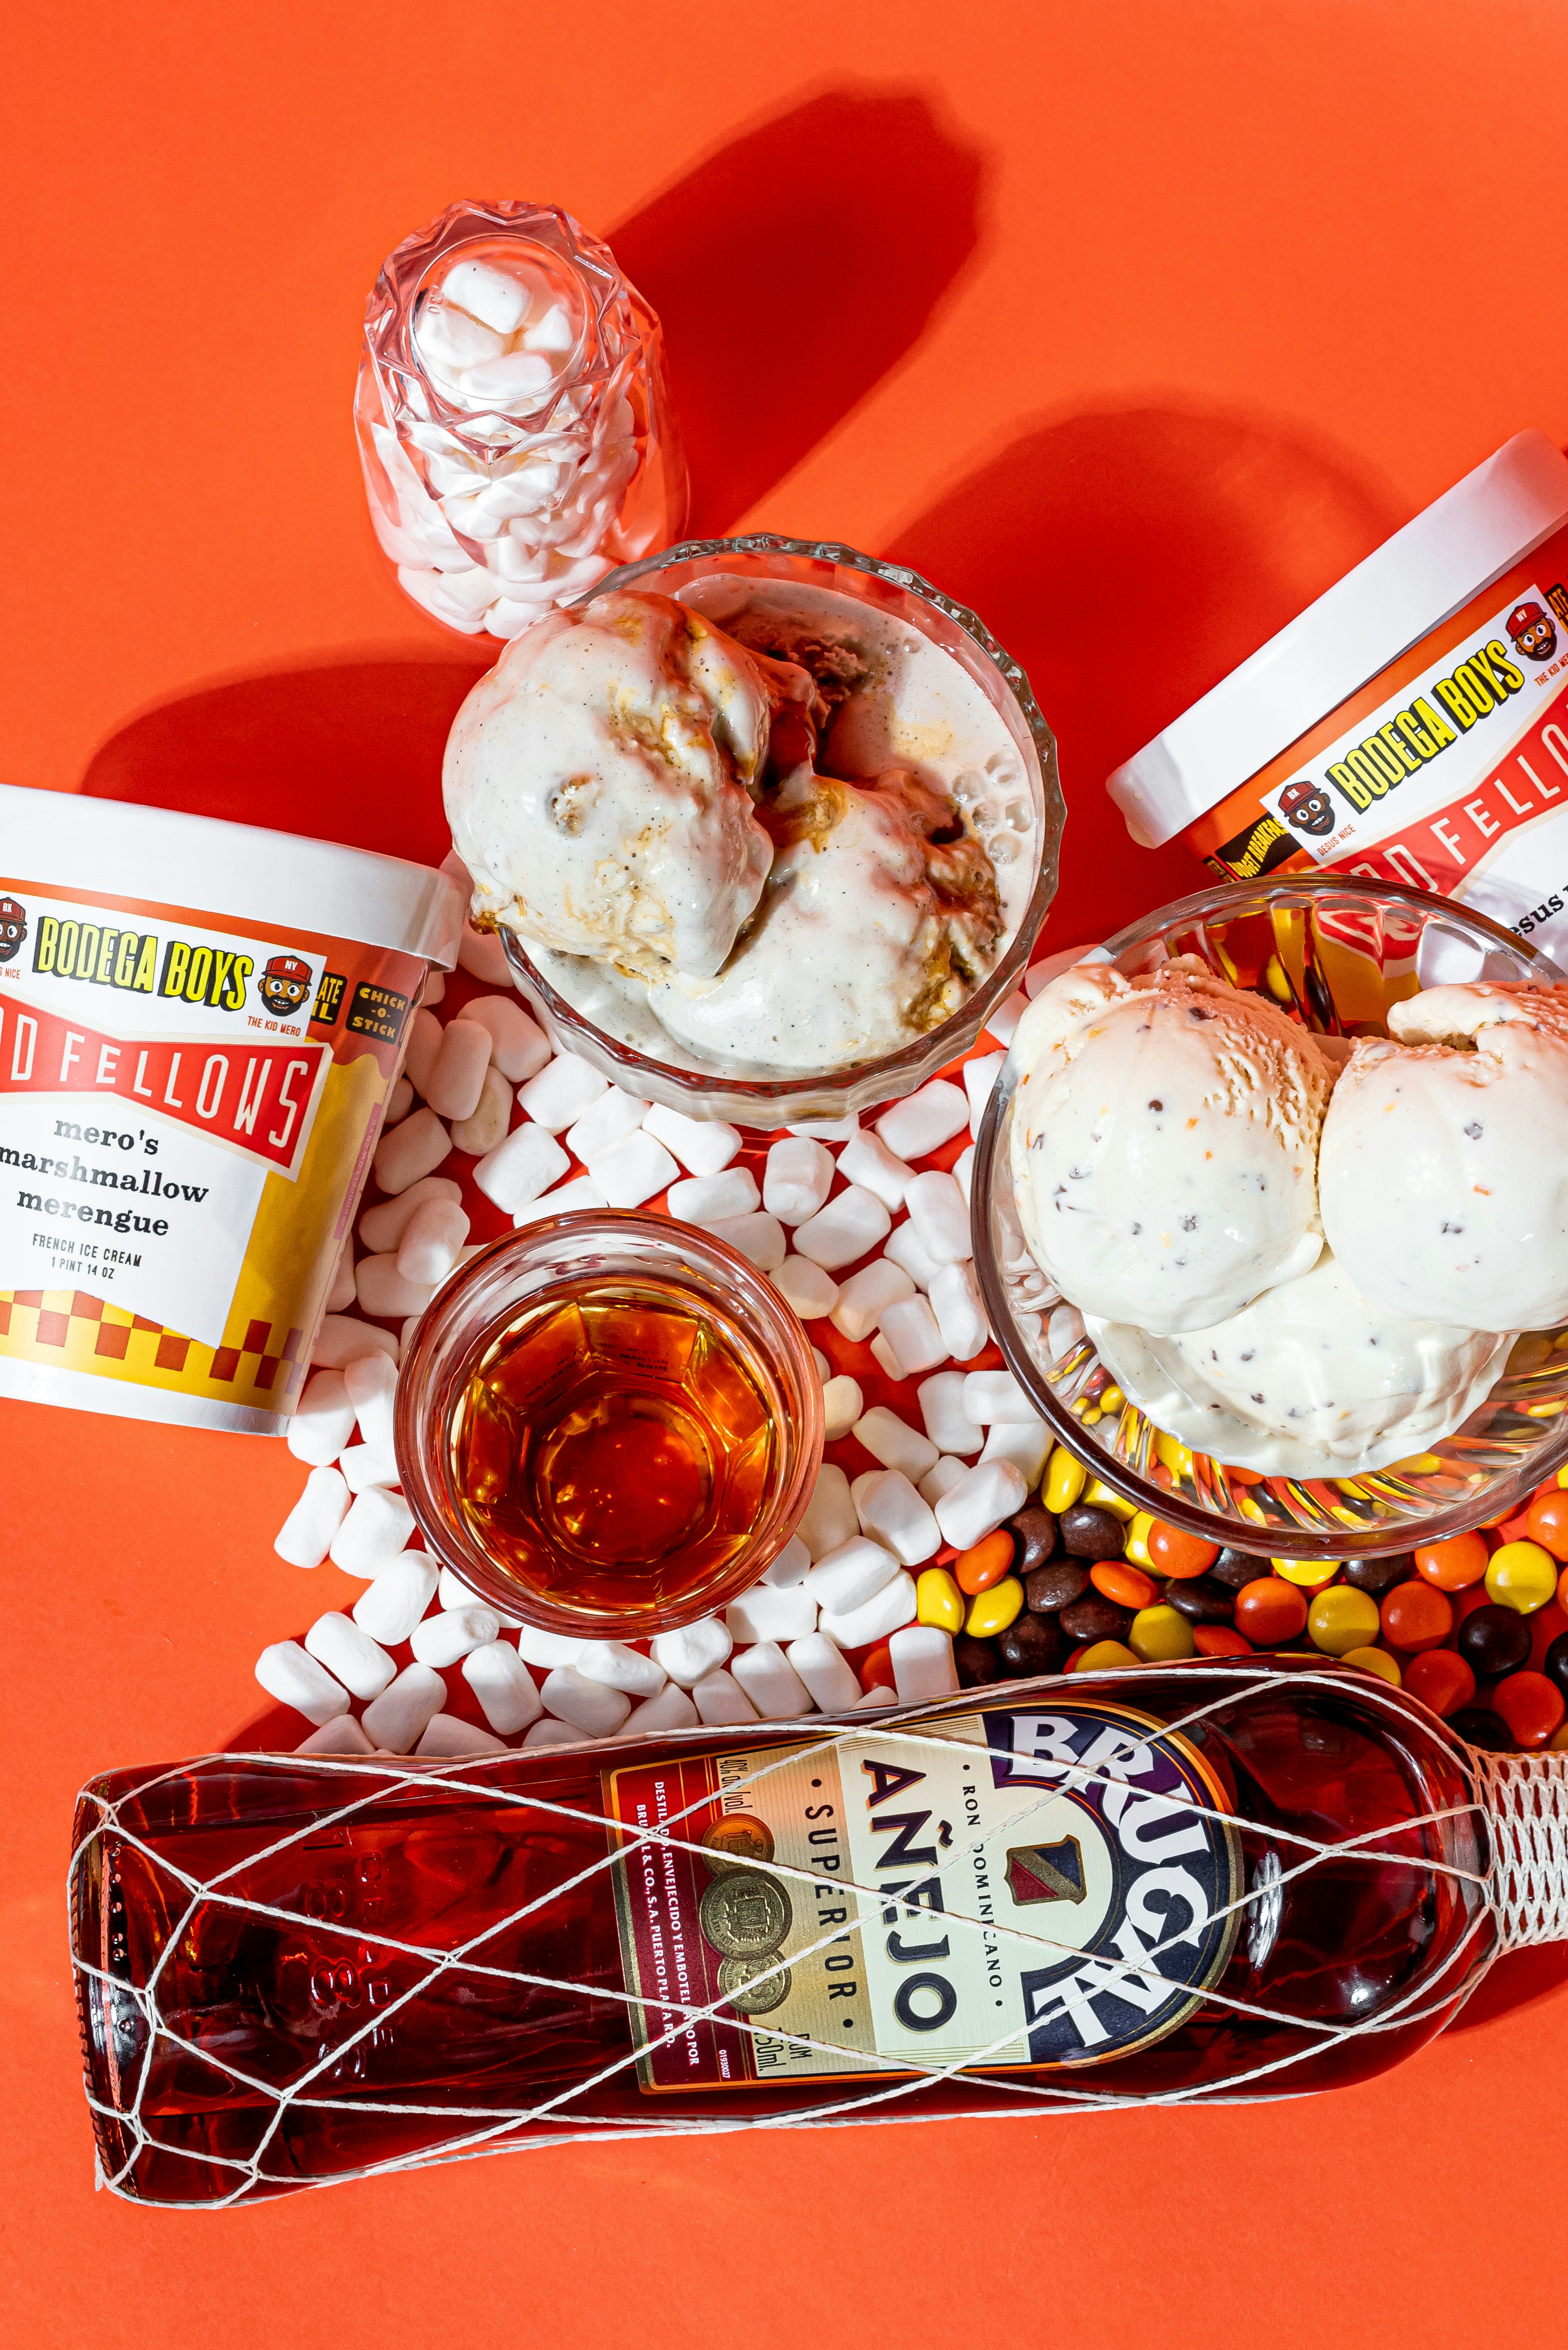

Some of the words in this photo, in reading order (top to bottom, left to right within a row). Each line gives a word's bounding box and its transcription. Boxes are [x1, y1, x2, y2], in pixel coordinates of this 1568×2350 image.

[1516, 609, 1528, 622] NY
[1534, 672, 1549, 687] THE
[1547, 663, 1560, 678] KID
[1325, 697, 1458, 814] BODEGA
[1431, 640, 1525, 734] BOYS
[1287, 788, 1300, 800] BK
[1429, 723, 1568, 865] FELLO
[1226, 851, 1261, 878] BUDGET
[1247, 817, 1289, 863] BREAKFAS
[1317, 837, 1340, 856] DESUS
[1337, 824, 1357, 840] NICE
[3, 903, 12, 913] BK
[5, 967, 21, 979] NICE
[32, 916, 158, 994] BODEGA
[157, 940, 254, 1012] BOYS
[285, 959, 298, 971] NY
[359, 988, 405, 1012] CHICK
[248, 1015, 263, 1028] THE
[265, 1019, 277, 1031] KID
[280, 1024, 301, 1037] MERO
[352, 1016, 397, 1039] STICK
[59, 1029, 308, 1148] FELLOWS
[53, 1120, 159, 1155] mero's
[0, 1146, 209, 1203] marshmallow
[17, 1191, 169, 1236] merengue
[33, 1233, 75, 1254] FRENCH
[80, 1243, 99, 1258] ICE
[103, 1248, 142, 1267] CREAM
[51, 1256, 56, 1267] 1
[60, 1259, 83, 1273] PINT
[87, 1264, 97, 1275] 14
[102, 1267, 115, 1280] OZ
[719, 1759, 749, 1774] 40%
[962, 1785, 981, 1827] RON
[642, 1855, 652, 1866] &
[861, 1758, 958, 2033] AÑEJO
[1007, 1715, 1211, 2048] BRUGAL
[804, 1804, 855, 2000] SUPERIOR
[651, 1925, 667, 1976] PUERTO
[662, 1852, 682, 1930] ENVEJECIDO
[687, 2041, 699, 2065] POR
[657, 1977, 672, 2021] PLAA
[719, 2049, 731, 2079] 01930027
